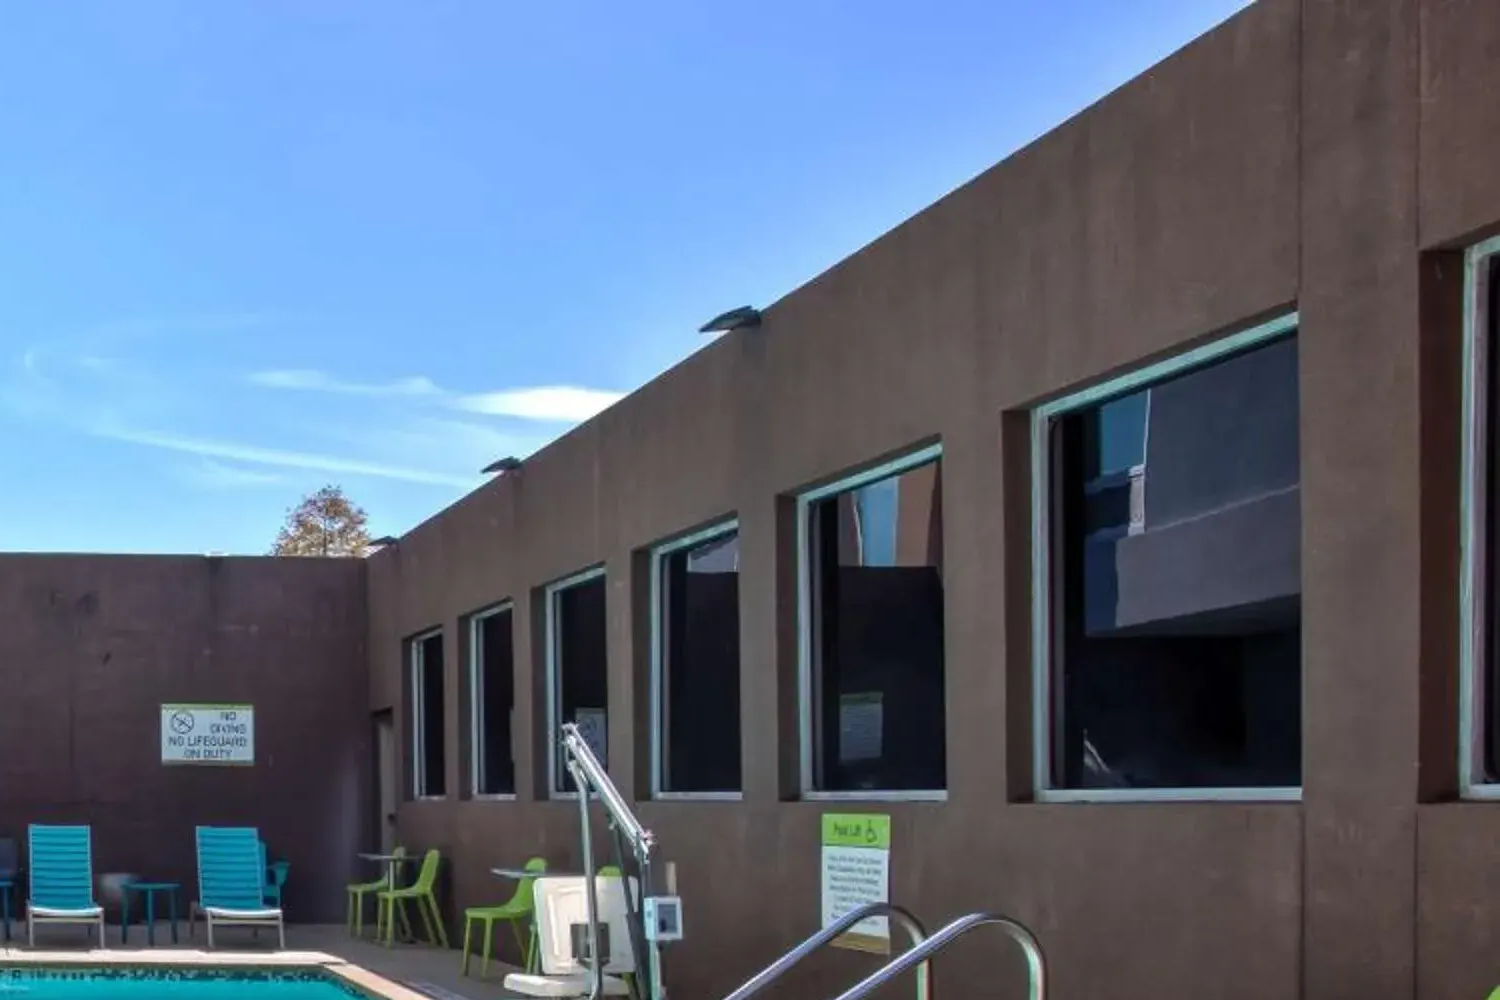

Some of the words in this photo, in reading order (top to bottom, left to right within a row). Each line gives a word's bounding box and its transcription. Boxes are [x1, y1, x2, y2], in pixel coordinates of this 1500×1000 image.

[220, 711, 237, 721] NO
[209, 723, 247, 734] DIVING
[169, 735, 185, 747] NO
[187, 735, 248, 747] LIFEGUARD
[183, 749, 201, 759] ON
[203, 749, 233, 759] DUTY
